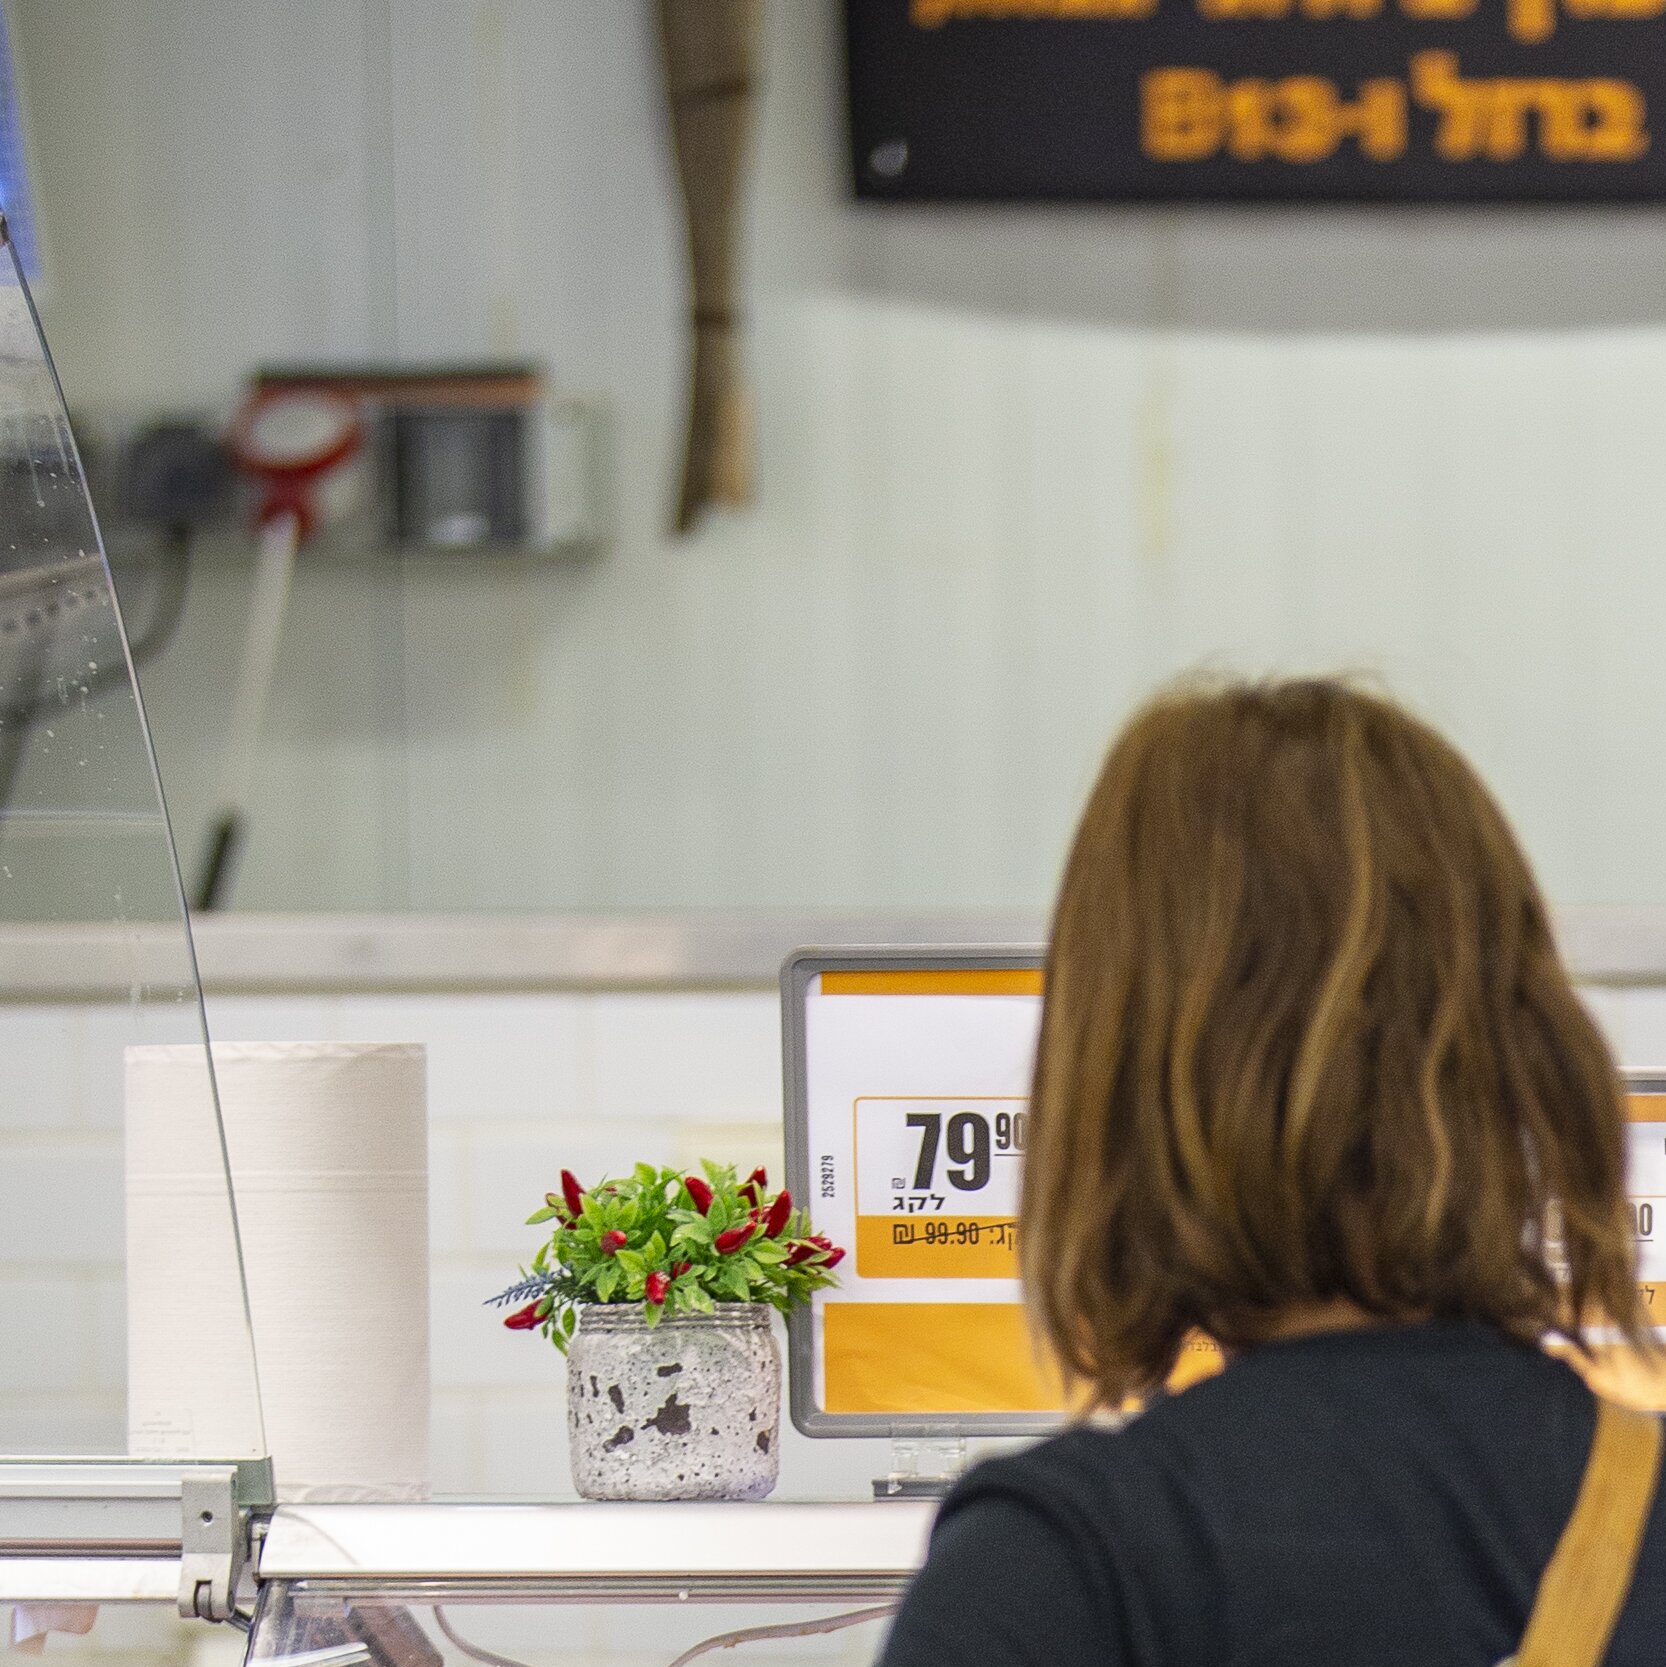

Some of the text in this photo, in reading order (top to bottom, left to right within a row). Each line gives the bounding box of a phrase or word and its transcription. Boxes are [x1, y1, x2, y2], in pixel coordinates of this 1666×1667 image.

[906, 1112, 990, 1191] 79
[821, 1155, 834, 1198] 2529279
[893, 1194, 945, 1213] לקג
[925, 1222, 979, 1245] 99.90
